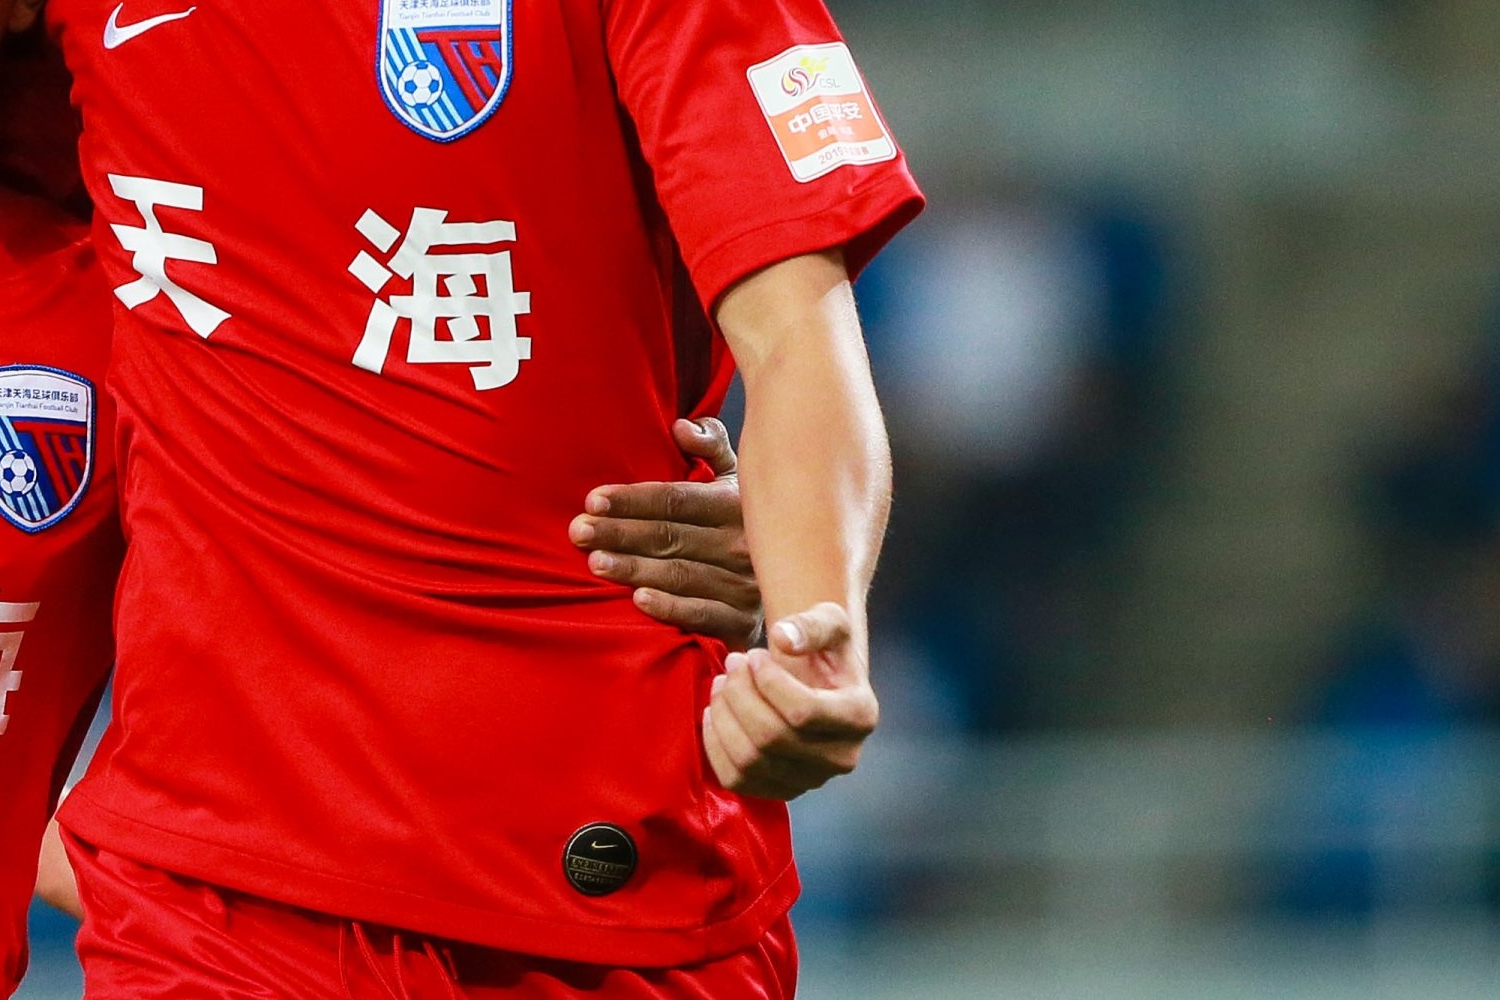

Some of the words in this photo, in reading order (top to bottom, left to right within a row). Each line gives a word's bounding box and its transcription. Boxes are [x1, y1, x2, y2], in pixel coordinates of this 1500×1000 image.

[819, 77, 841, 88] CSL
[787, 102, 863, 133] 中国平安
[107, 173, 232, 339] 天
[347, 206, 532, 391] 海
